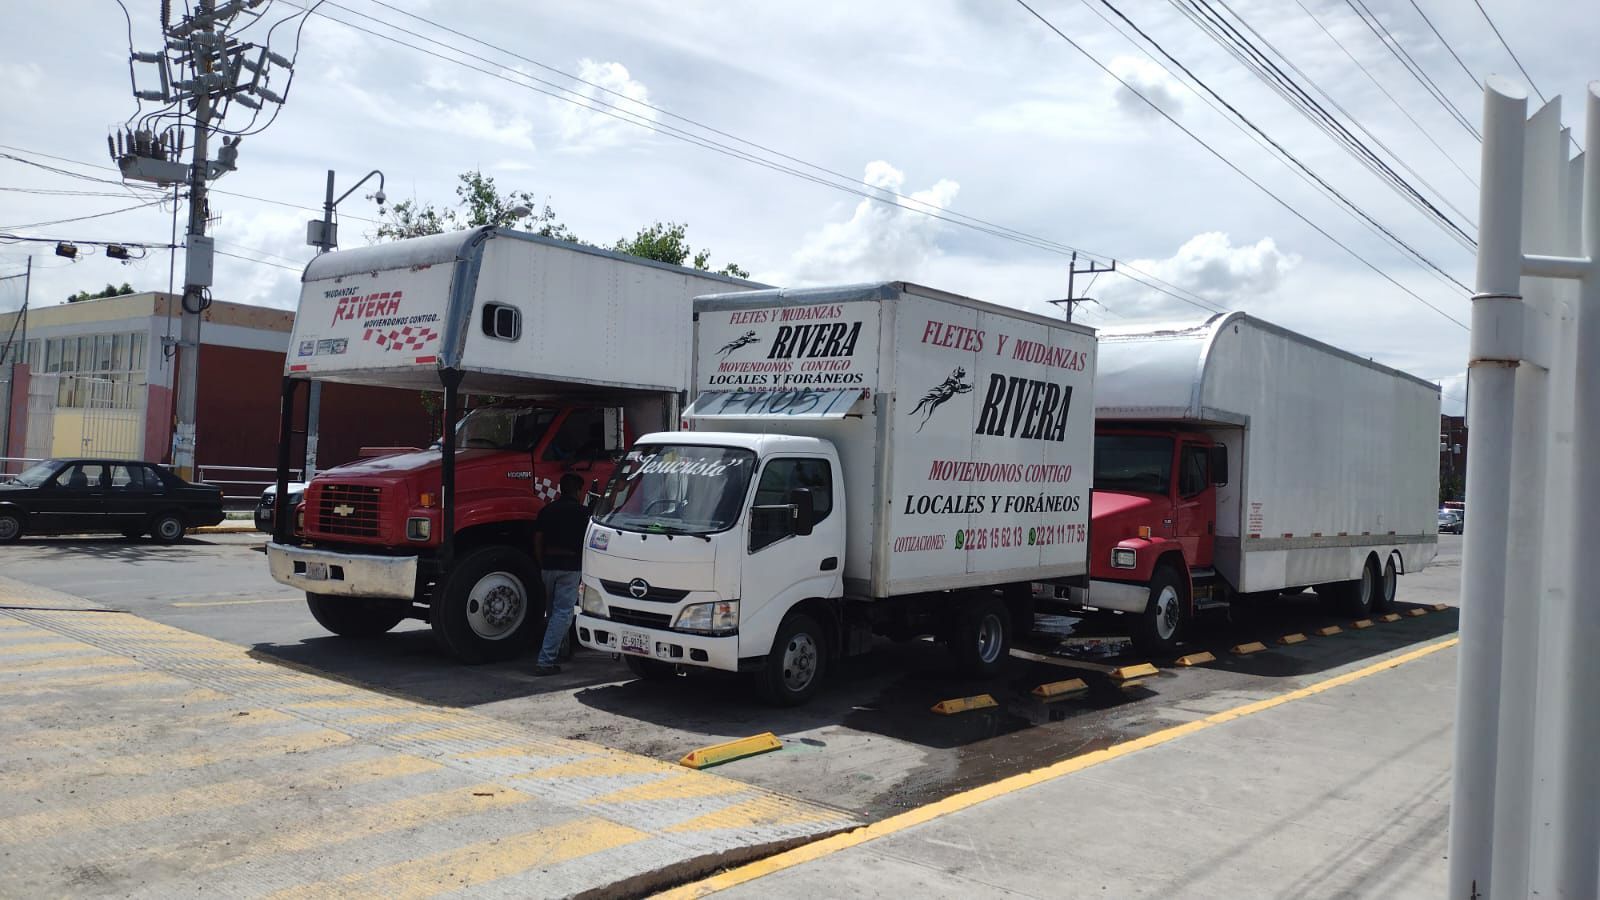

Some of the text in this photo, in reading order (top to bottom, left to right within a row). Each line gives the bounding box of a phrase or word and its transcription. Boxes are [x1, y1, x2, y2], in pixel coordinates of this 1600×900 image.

[331, 290, 403, 328] RIVERA
[729, 305, 844, 325] FLETES Y MUDANZAS
[363, 317, 408, 328] MOVIENDONOS
[767, 321, 863, 360] RIVERA
[921, 320, 1087, 372] FLETES Y MUDANZAS
[717, 359, 852, 373] MOVIENDONOS CONTIGO
[708, 371, 864, 385] LOCALES Y FORÁNEOS
[975, 373, 1073, 442] RIVERA
[928, 460, 1072, 483] MOVIENDONOS CONTIGO
[904, 492, 1080, 515] LOCALES Y FORÁNEOS
[964, 529, 975, 550] 22
[977, 528, 987, 549] 26
[990, 527, 999, 548] 15
[1001, 527, 1011, 547] 62
[1013, 526, 1022, 547] 13
[1036, 526, 1045, 546] 22
[1046, 525, 1054, 545] 21
[1057, 524, 1065, 544] 11
[1067, 524, 1075, 543] 77
[1076, 524, 1085, 542] 56
